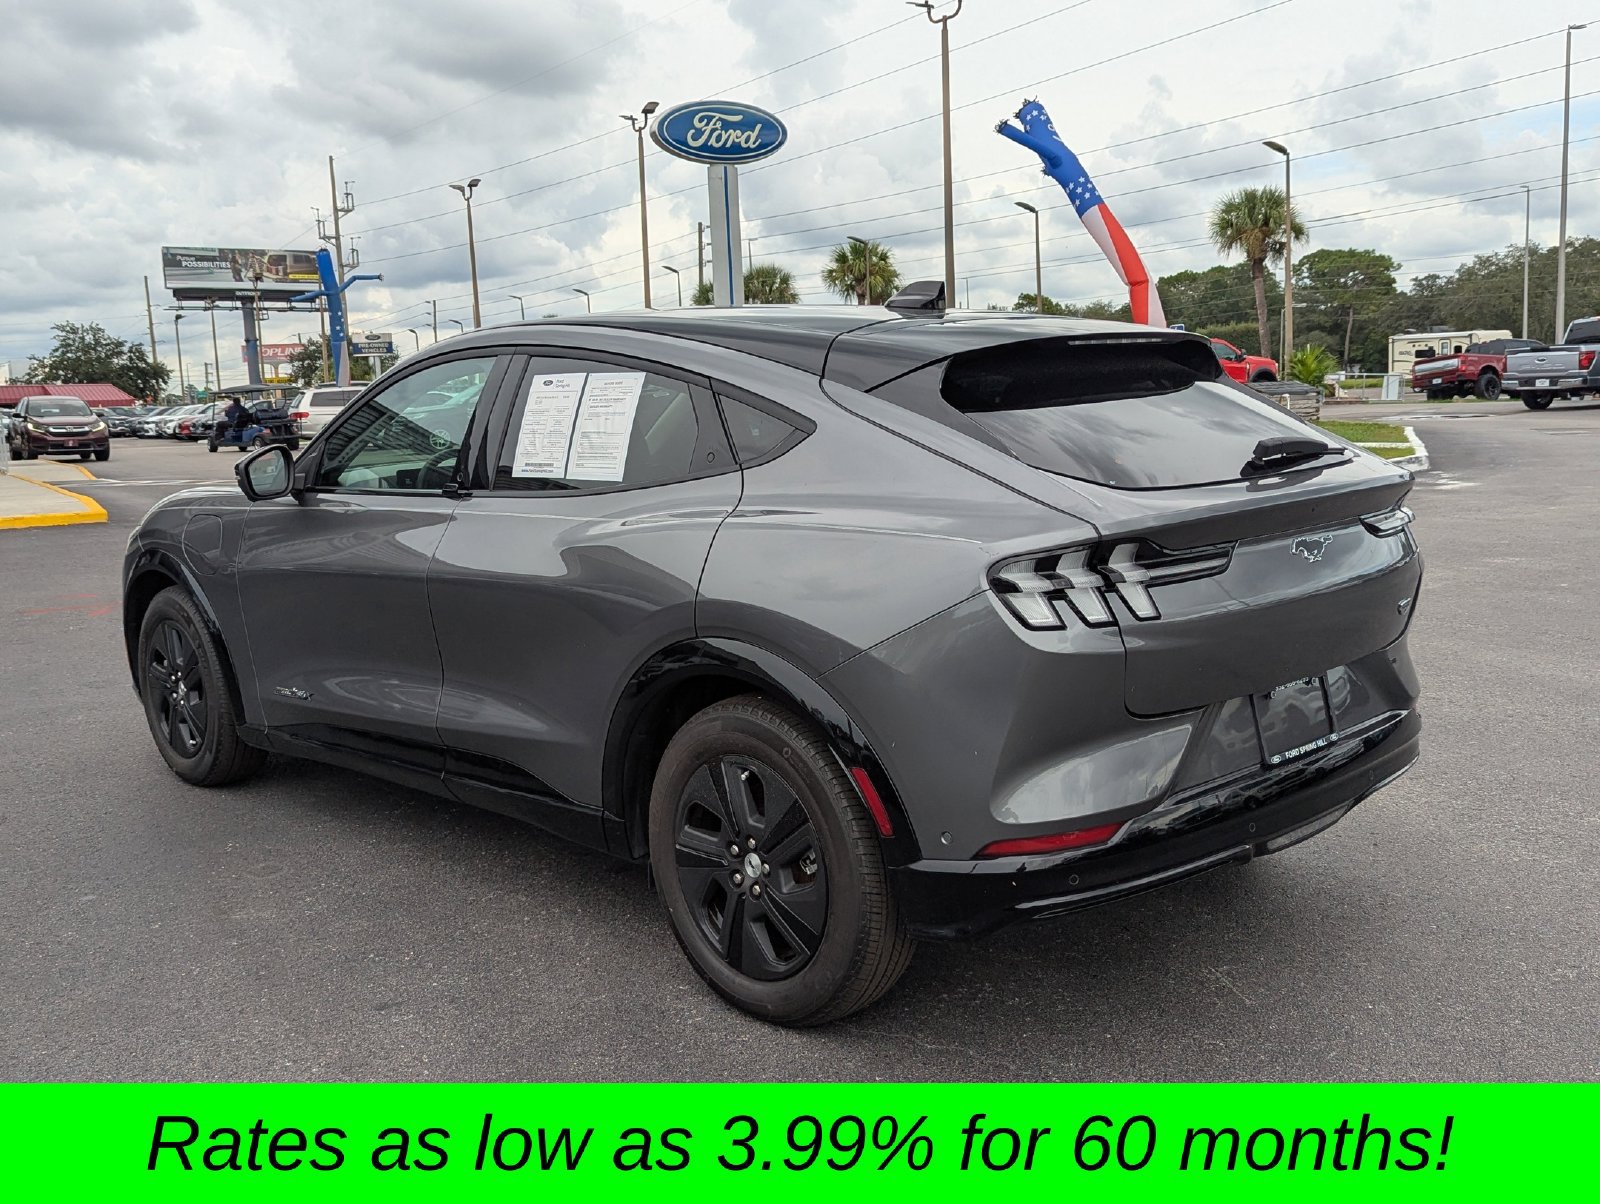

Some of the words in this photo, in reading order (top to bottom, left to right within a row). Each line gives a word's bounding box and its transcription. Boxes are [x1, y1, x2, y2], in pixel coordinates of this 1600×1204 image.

[687, 111, 762, 149] Ford
[182, 261, 231, 269] POSSIBILITIES
[1285, 749, 1300, 759] FORD
[1300, 742, 1316, 754] SPRING
[1316, 738, 1328, 748] HILL
